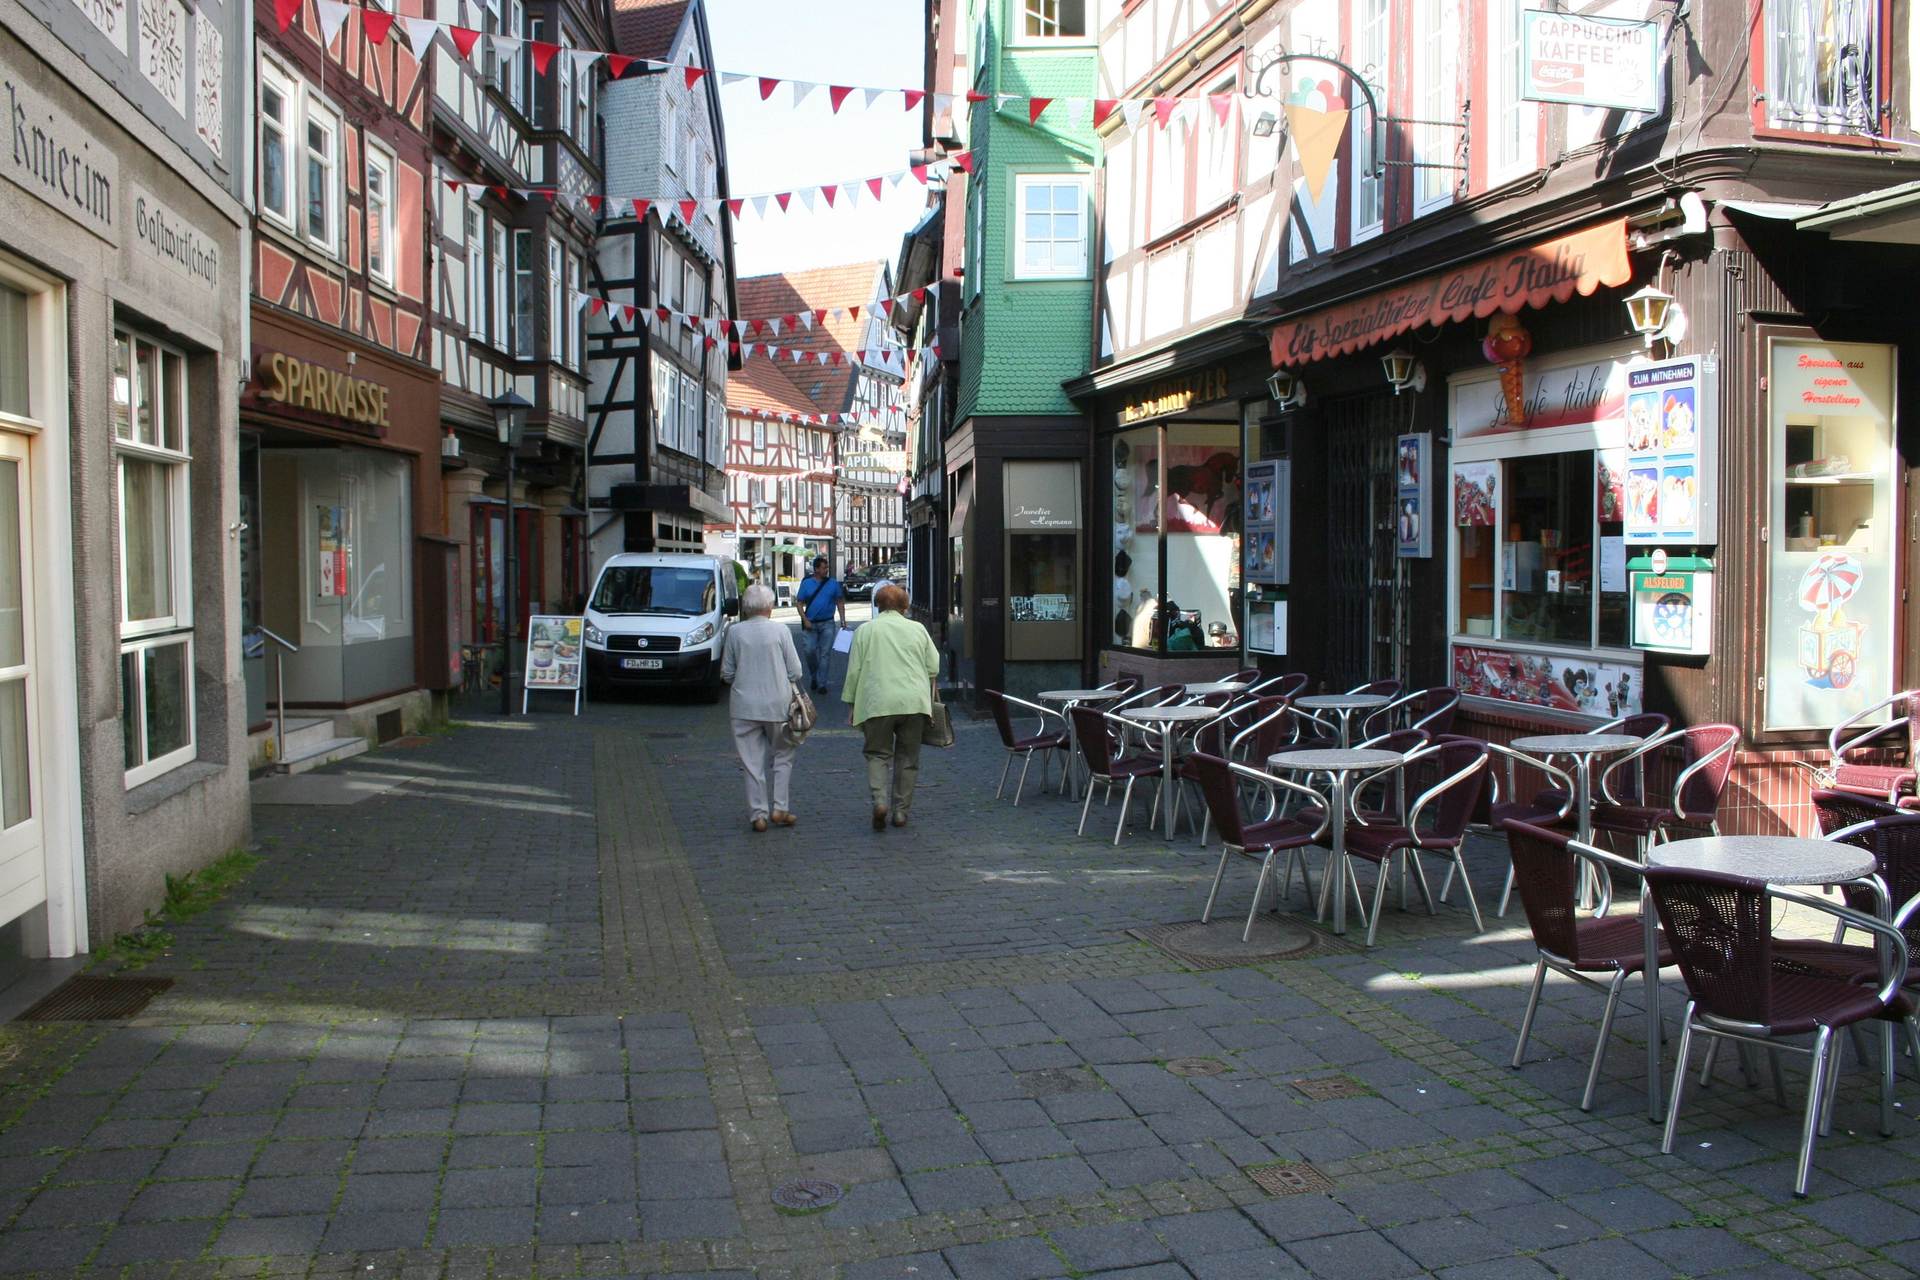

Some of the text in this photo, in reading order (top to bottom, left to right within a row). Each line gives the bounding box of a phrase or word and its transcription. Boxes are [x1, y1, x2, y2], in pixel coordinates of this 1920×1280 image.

[1539, 20, 1642, 45] CAPPUCCINO
[1540, 40, 1613, 64] KAFFEE
[1505, 244, 1588, 297] Italia
[1847, 359, 1864, 369] aus
[1633, 372, 1650, 385] ZUM
[1651, 366, 1693, 383] MITNEHMEN
[1814, 377, 1848, 388] eigener
[271, 352, 390, 427] SPARKASSE
[1802, 391, 1861, 407] Herstellung
[847, 455, 903, 468] APOTHE
[1014, 505, 1051, 517] Juwelier
